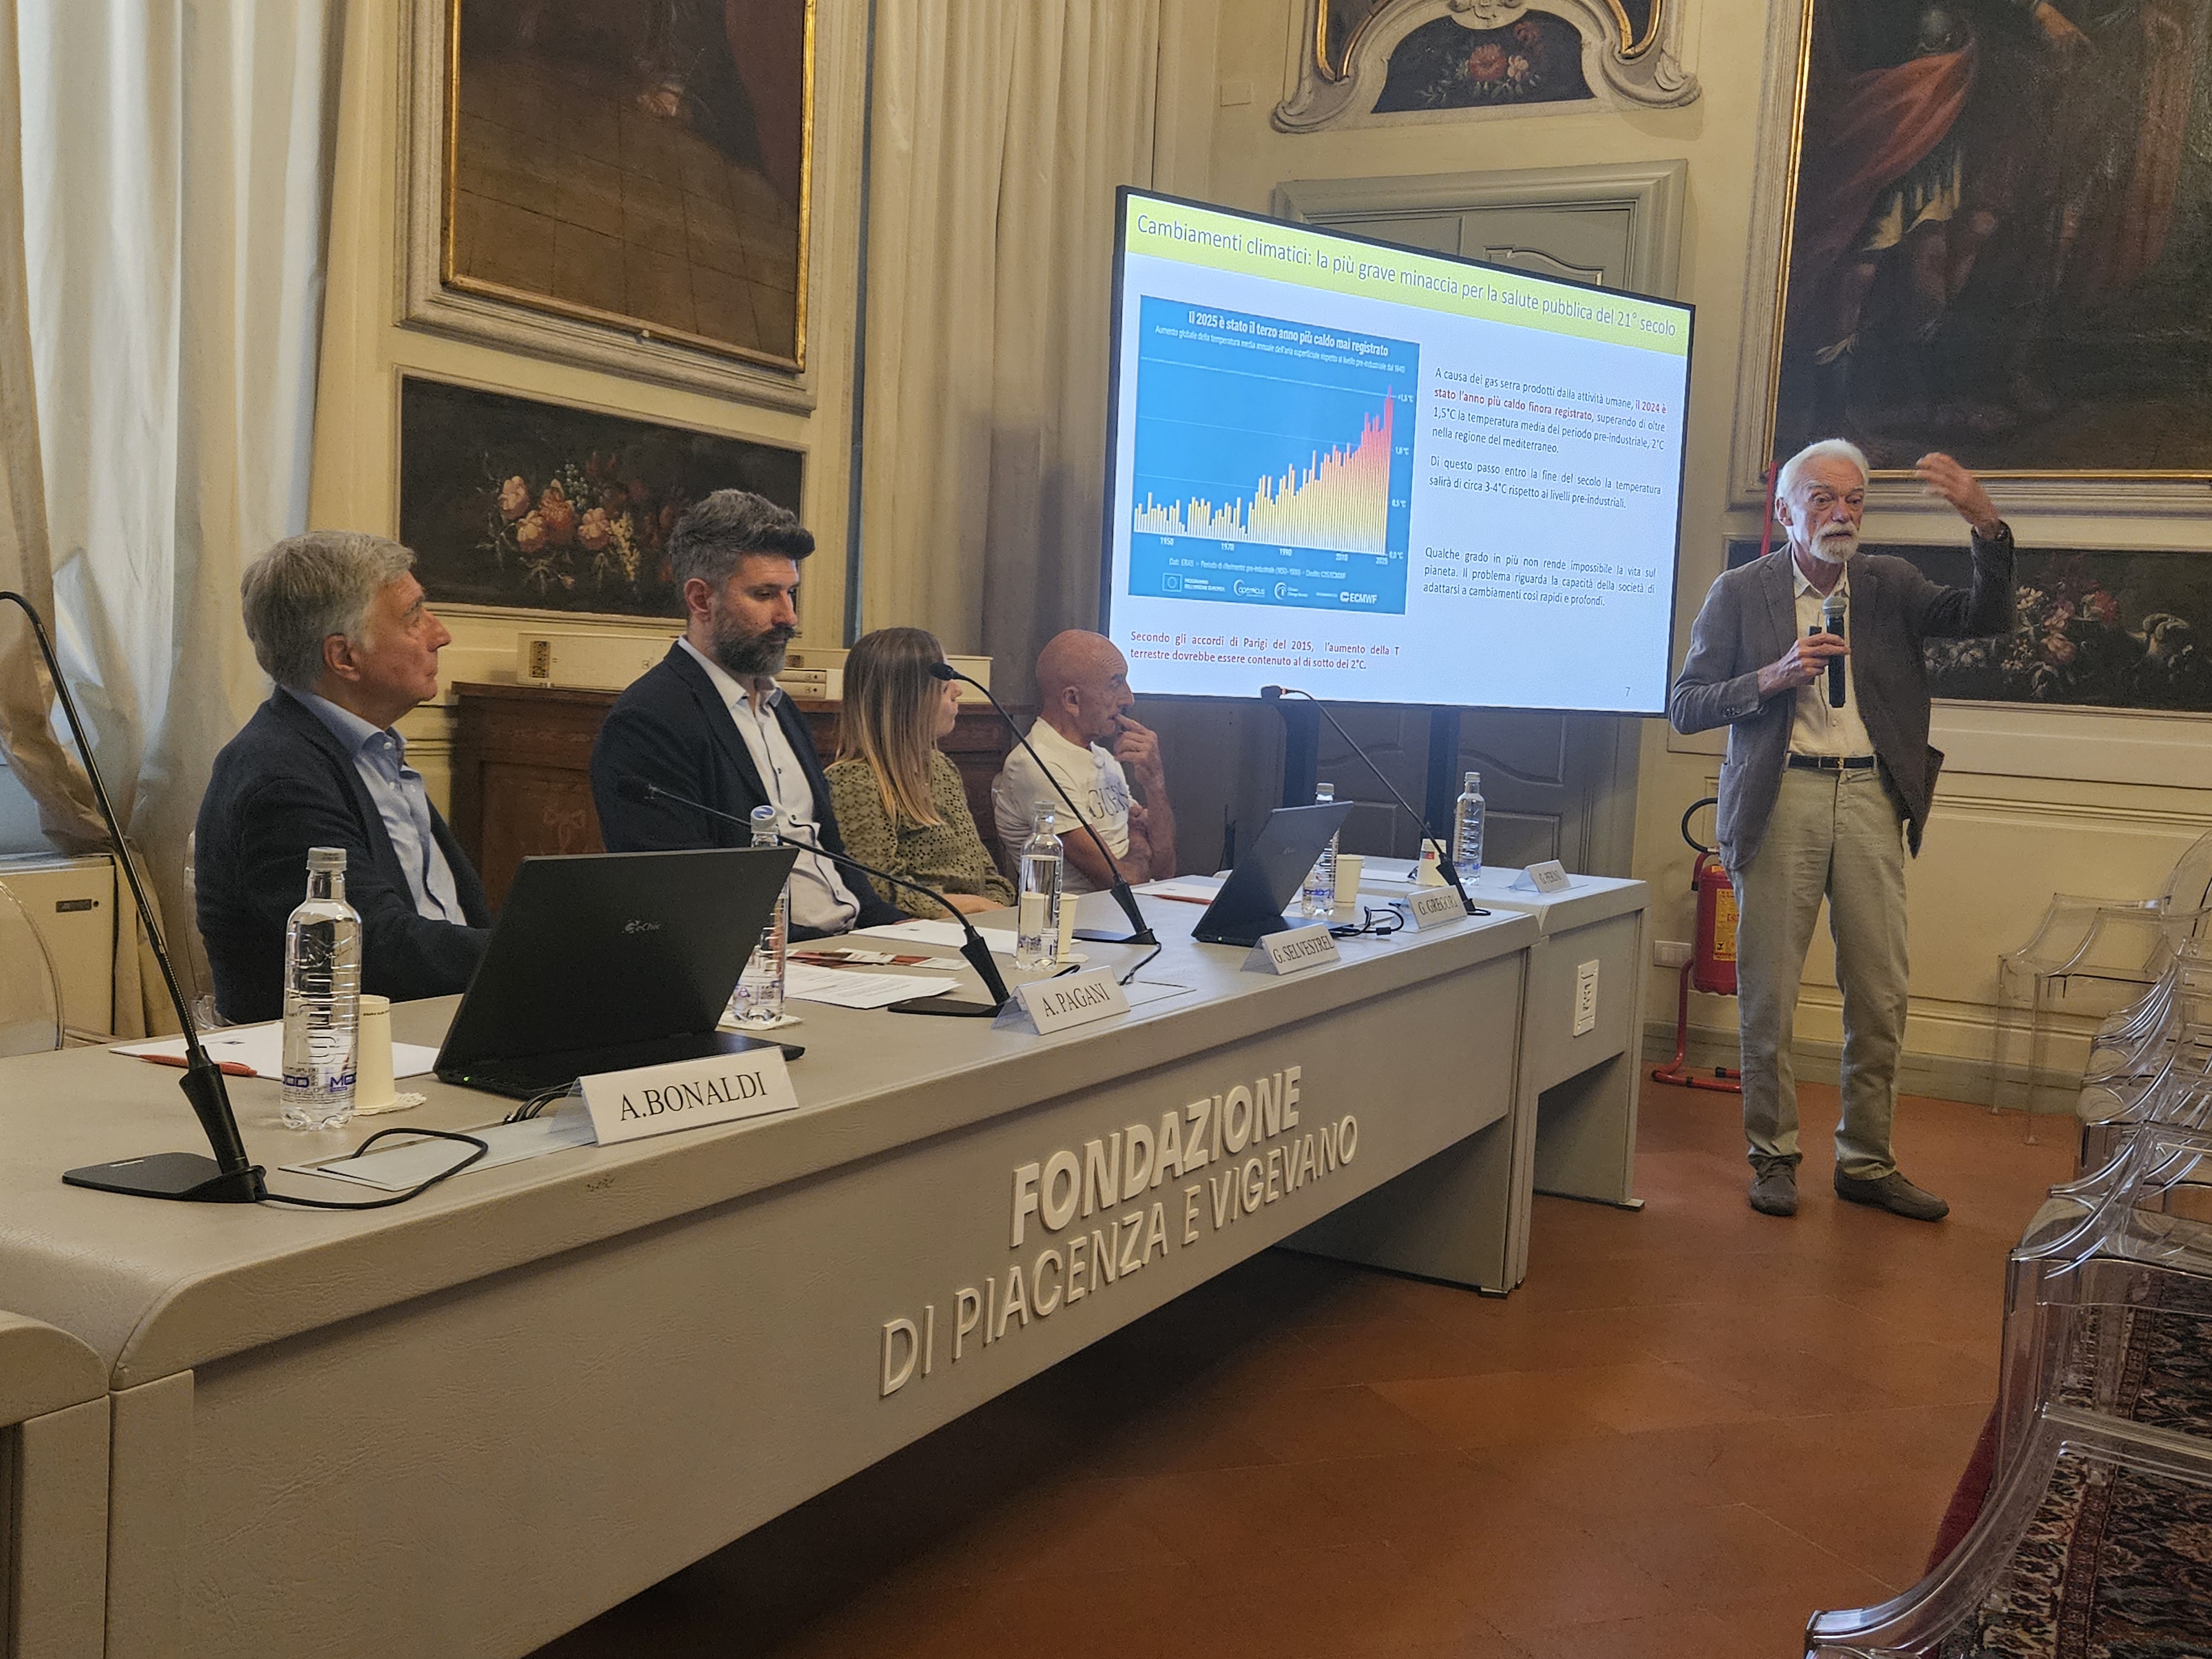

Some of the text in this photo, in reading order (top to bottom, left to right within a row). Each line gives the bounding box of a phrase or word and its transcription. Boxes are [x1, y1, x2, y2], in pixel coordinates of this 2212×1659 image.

[1138, 215, 1675, 336] Cambiamenti climatici: la più grave minaccia per la salute pubblica del 21° secolo
[1188, 311, 1388, 356] Il 2025 è stato il terzo anno più caldo mai registrato
[1435, 367, 1441, 378] A
[1444, 371, 1467, 382] causa
[1484, 378, 1498, 388] gas
[1500, 380, 1520, 390] serra
[1522, 384, 1555, 395] prodotti
[1557, 387, 1574, 399] dalla
[1577, 392, 1603, 404] attività
[1605, 397, 1633, 410] umane,
[1636, 399, 1640, 409] il
[1642, 401, 1659, 413] 2024
[1662, 403, 1666, 414] è
[1434, 388, 1455, 399] stato
[1488, 395, 1500, 407] più
[1504, 398, 1525, 410] caldo
[1528, 401, 1551, 414] finora
[1555, 406, 1594, 422] registrato,
[1597, 414, 1636, 427] superando
[1639, 419, 1645, 428] di
[1648, 420, 1665, 431] oltre
[1432, 427, 1558, 453] nella regione del mediterraneo.
[1458, 409, 1464, 421] la
[1468, 413, 1518, 428] temperatura
[1521, 421, 1545, 432] media
[1547, 423, 1559, 434] del
[1562, 427, 1592, 439] periodo
[1594, 432, 1649, 449] pre-industriale,
[1431, 456, 1660, 494] Di questo passo entro la fine del secolo la temperatura
[1429, 476, 1451, 487] salirà
[1453, 478, 1461, 488] di
[1463, 479, 1482, 491] circa
[1509, 484, 1539, 498] rispetto
[1541, 489, 1548, 499] ai
[1550, 489, 1570, 500] livelli
[1572, 494, 1626, 508] pre-industriali.
[1160, 537, 1174, 546] 1950
[1221, 542, 1235, 551] 1970
[1425, 547, 1656, 577] Qualche grado in più non rende impossibile la vita sul
[1423, 582, 1459, 594] adattarsi
[1469, 586, 1521, 599] cambiamenti
[1523, 591, 1538, 601] così
[1540, 592, 1562, 604] rapidi
[1571, 594, 1604, 606] profondi.
[1425, 564, 1654, 593] pianeta. Il problema riguarda la capacità della società di
[1349, 593, 1378, 604] ECMWF
[1130, 631, 1170, 642] Secondo
[1175, 633, 1186, 645] gli
[1192, 635, 1224, 645] accordi
[1230, 636, 1238, 646] di
[1244, 638, 1267, 650] Parigi
[1273, 638, 1286, 649] del
[1291, 640, 1313, 652] 2015,
[1370, 644, 1389, 654] della
[1395, 646, 1399, 655] T
[1130, 649, 1170, 659] terrestre
[1172, 649, 1215, 661] dovrebbe
[1248, 655, 1291, 665] contenuto
[1293, 656, 1301, 666] al
[1303, 656, 1311, 666] di
[1313, 659, 1334, 667] sotto
[1625, 686, 1631, 697] 7
[1273, 948, 1286, 963] G.
[1042, 983, 1110, 1017] A. PAGANI
[620, 1071, 768, 1121] A.BONALDI
[1010, 1066, 1302, 1248] FONDAZIONE
[880, 1115, 1359, 1397] DI PIACENZA E VIGEVANO
